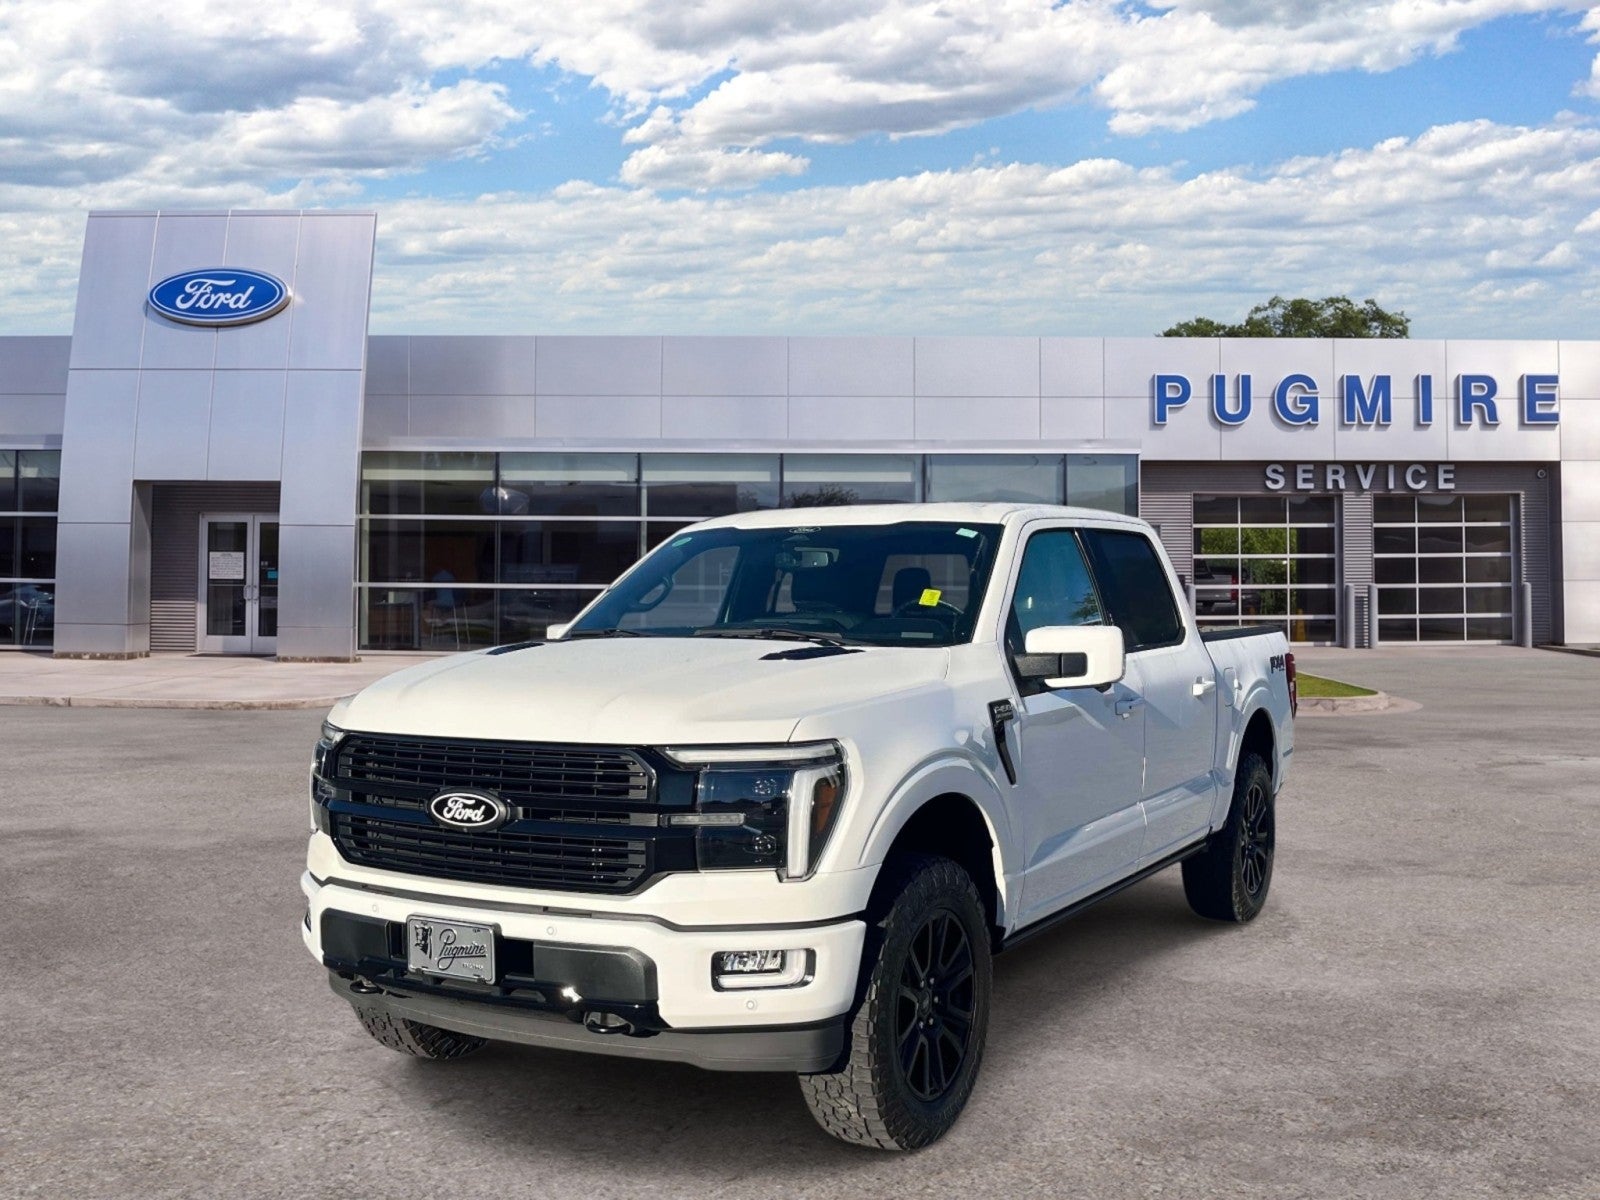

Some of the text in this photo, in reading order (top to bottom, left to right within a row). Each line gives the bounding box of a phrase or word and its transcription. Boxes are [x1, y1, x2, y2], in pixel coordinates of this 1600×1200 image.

[175, 278, 255, 309] Ford
[1152, 372, 1560, 427] PUGMIRE
[1264, 463, 1457, 491] SERVICE
[442, 796, 486, 821] Ford
[437, 928, 487, 971] Pugmire
